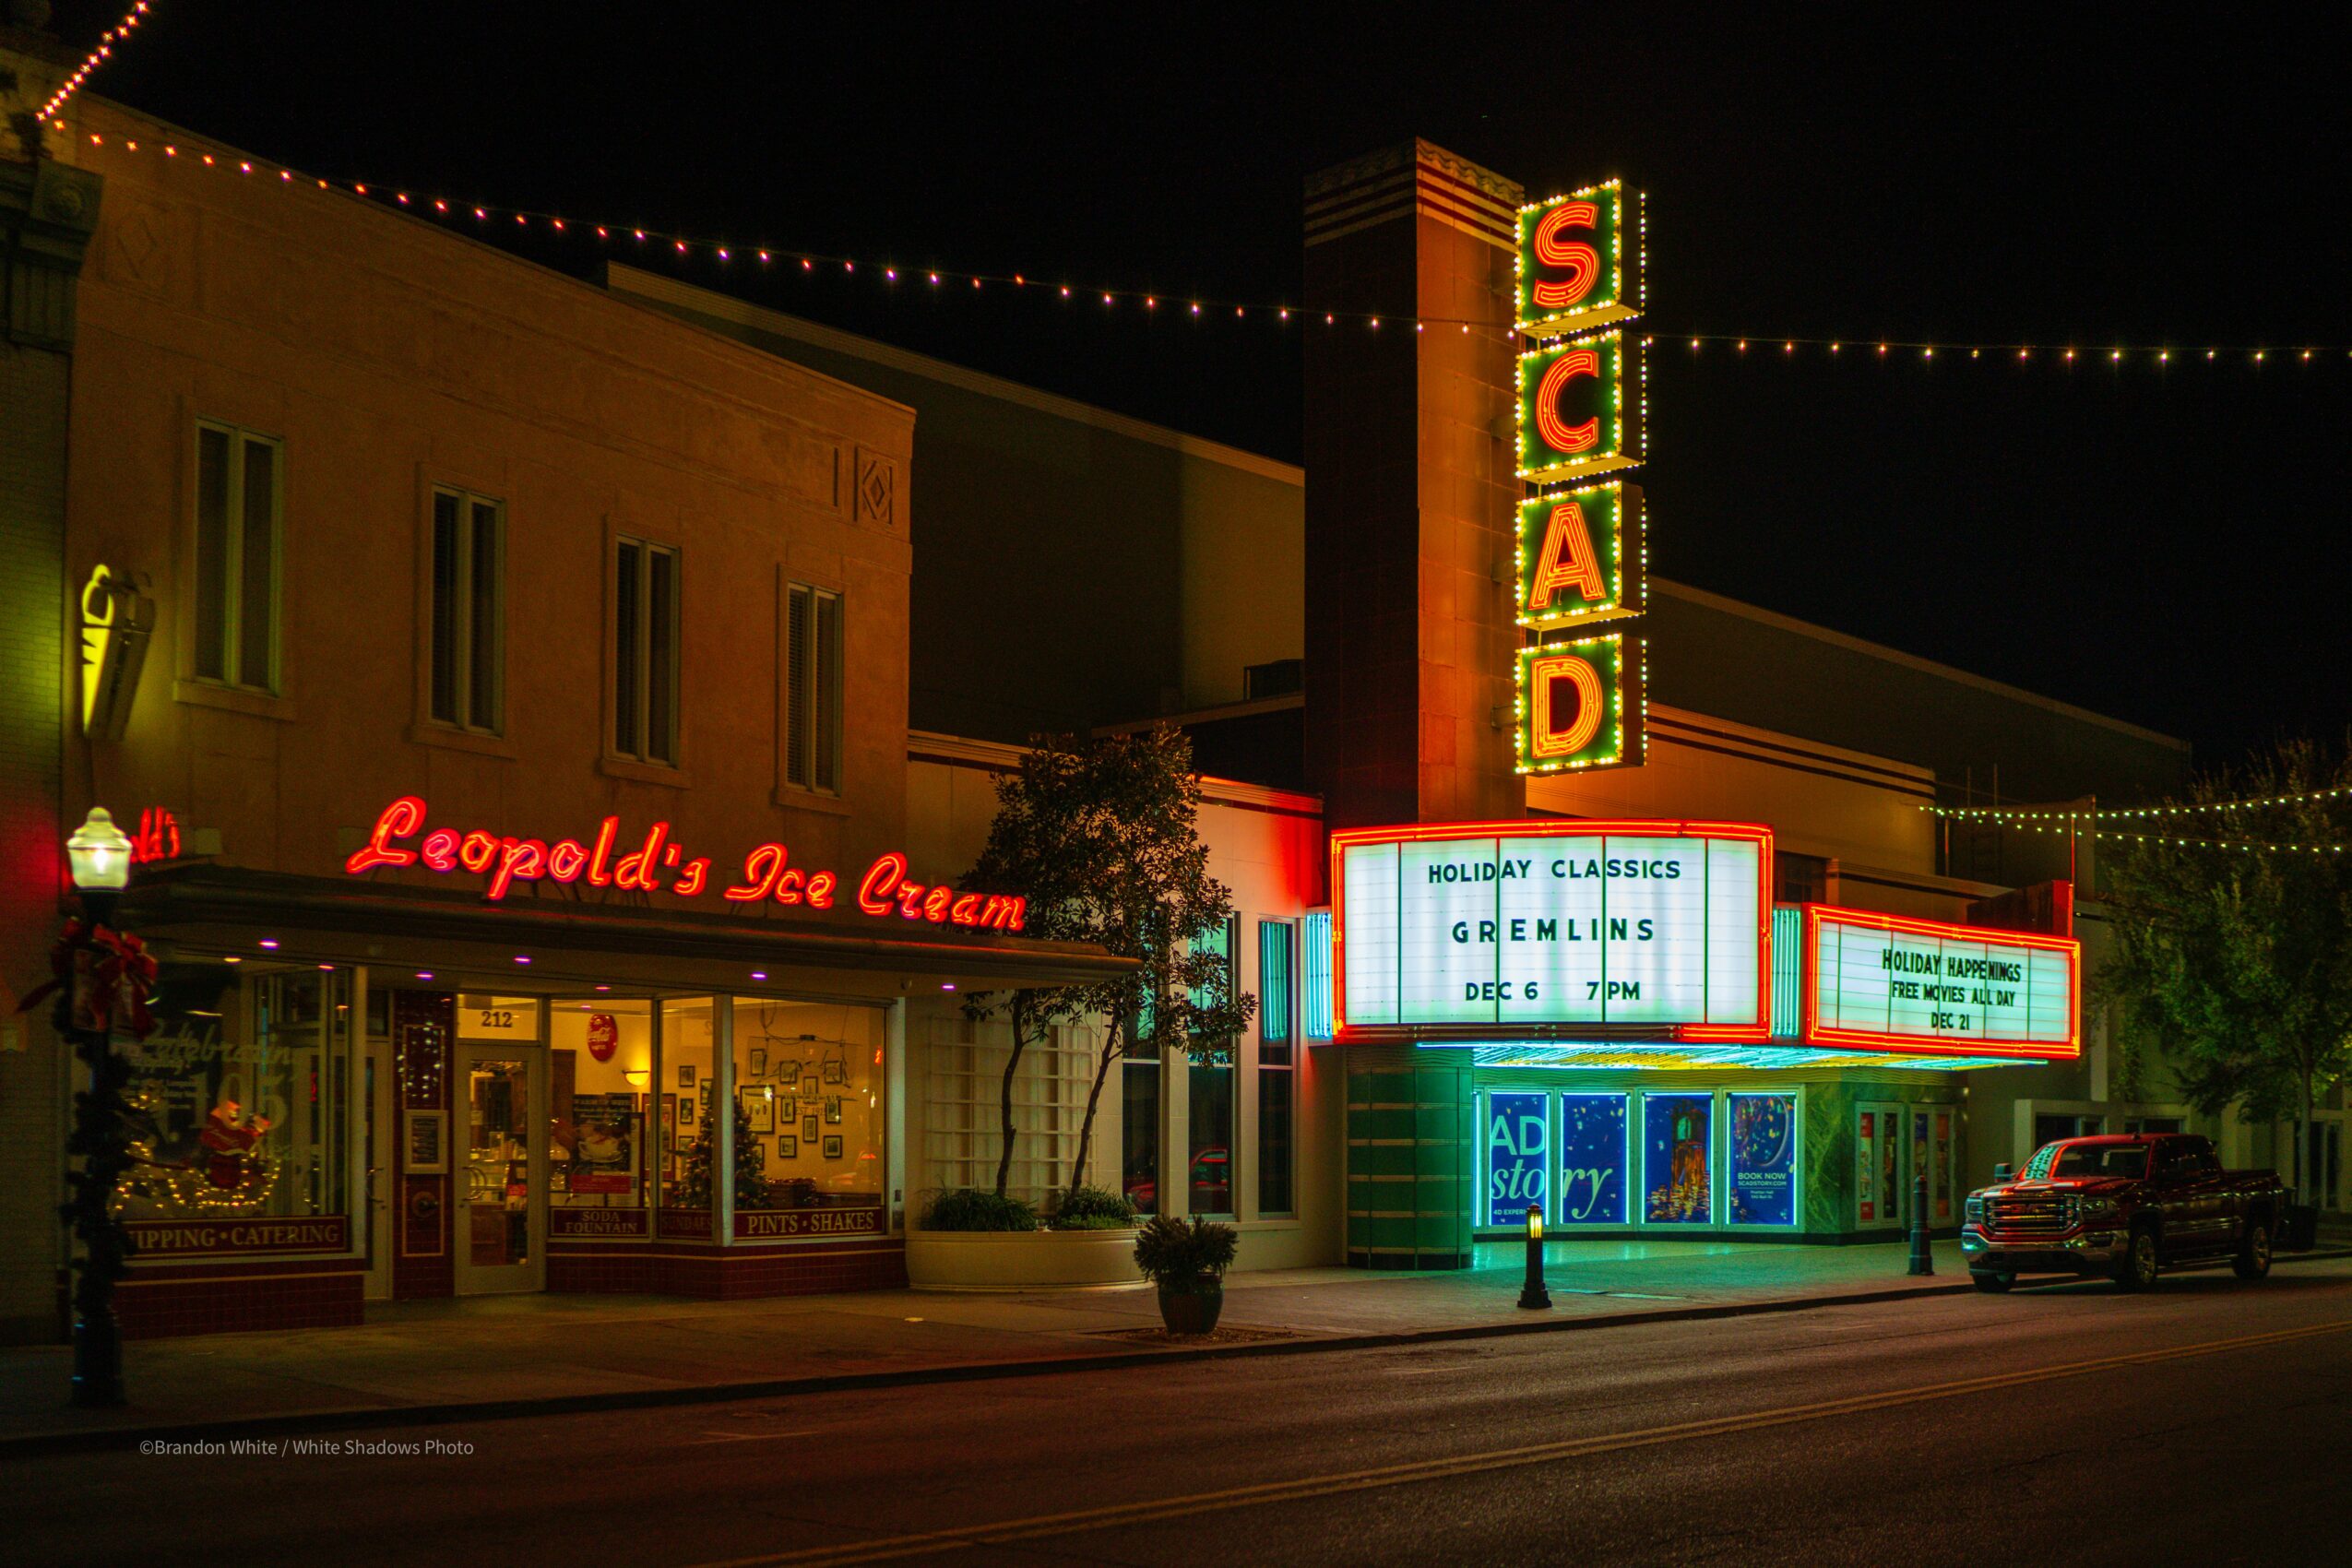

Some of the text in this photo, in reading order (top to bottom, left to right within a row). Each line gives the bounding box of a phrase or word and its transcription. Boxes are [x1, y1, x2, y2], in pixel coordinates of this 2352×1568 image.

[1528, 200, 1607, 759] SCAD
[346, 795, 1027, 931] Leopold's Ice Cream
[1428, 859, 1681, 884] HOLIDAY CLASSICS
[1452, 919, 1655, 944] GREMLINS
[1882, 948, 2022, 983] HOLIDAY HAPPENINGS
[1465, 980, 1513, 1002] DEC
[1524, 980, 1539, 1001] 6
[1892, 980, 2016, 1007] FREE MOVIES ALL DAY
[481, 1010, 514, 1028] 212
[1930, 1011, 1970, 1031] DEC 21
[1491, 1115, 1546, 1156] AD
[564, 1222, 638, 1234] FOUNTAIN
[581, 1210, 621, 1222] SODA
[747, 1211, 875, 1234] PINTS SHAKES
[231, 1224, 340, 1246] CATERING
